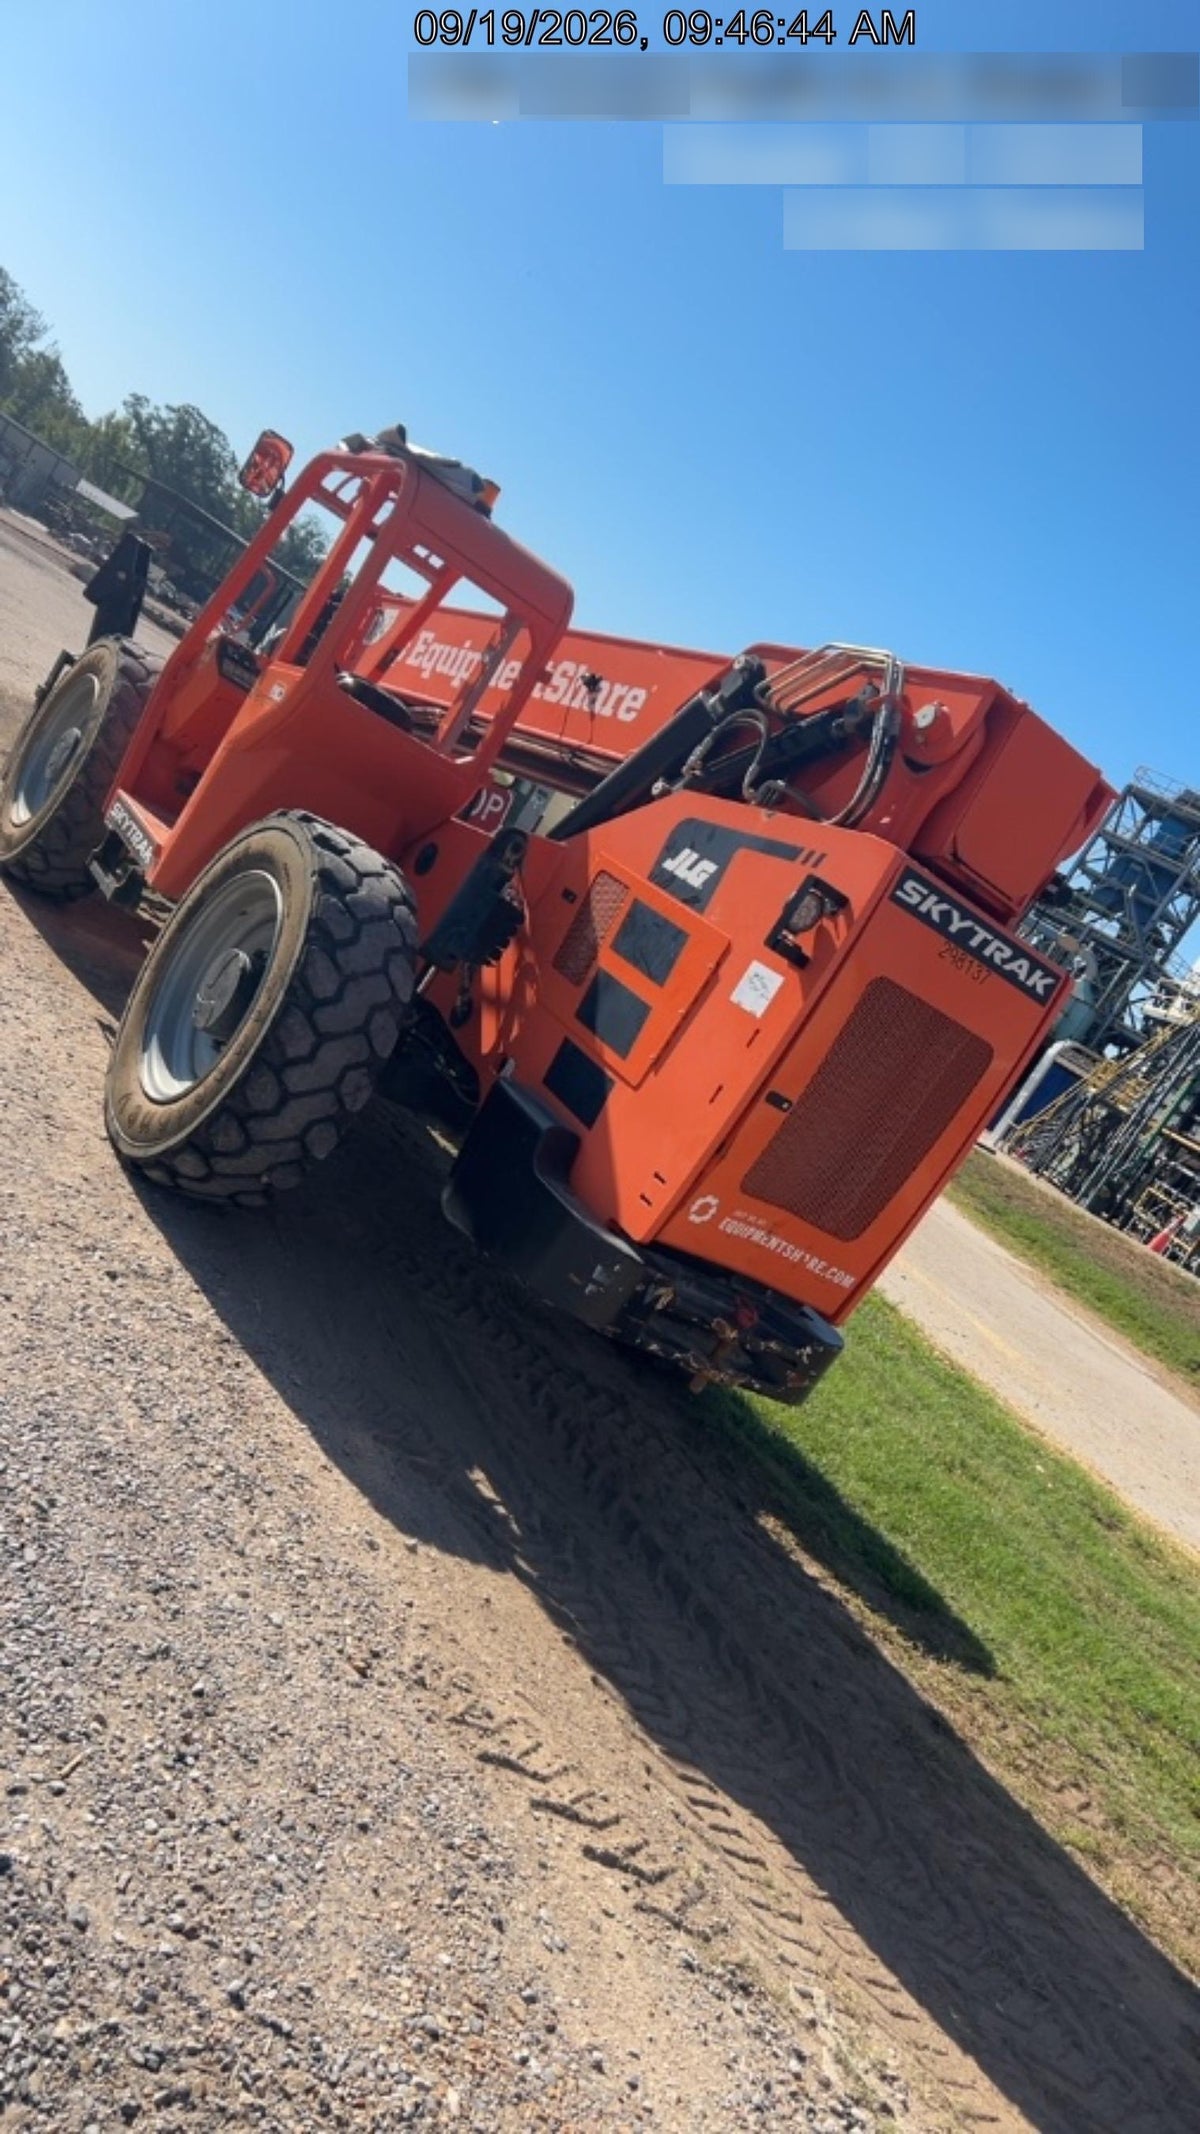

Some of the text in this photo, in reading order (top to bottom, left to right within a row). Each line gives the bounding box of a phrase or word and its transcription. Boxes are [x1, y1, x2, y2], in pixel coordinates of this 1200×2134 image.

[404, 630, 649, 723] EquipeShare
[661, 848, 719, 888] JLG
[895, 879, 1055, 997] SKYTRAK
